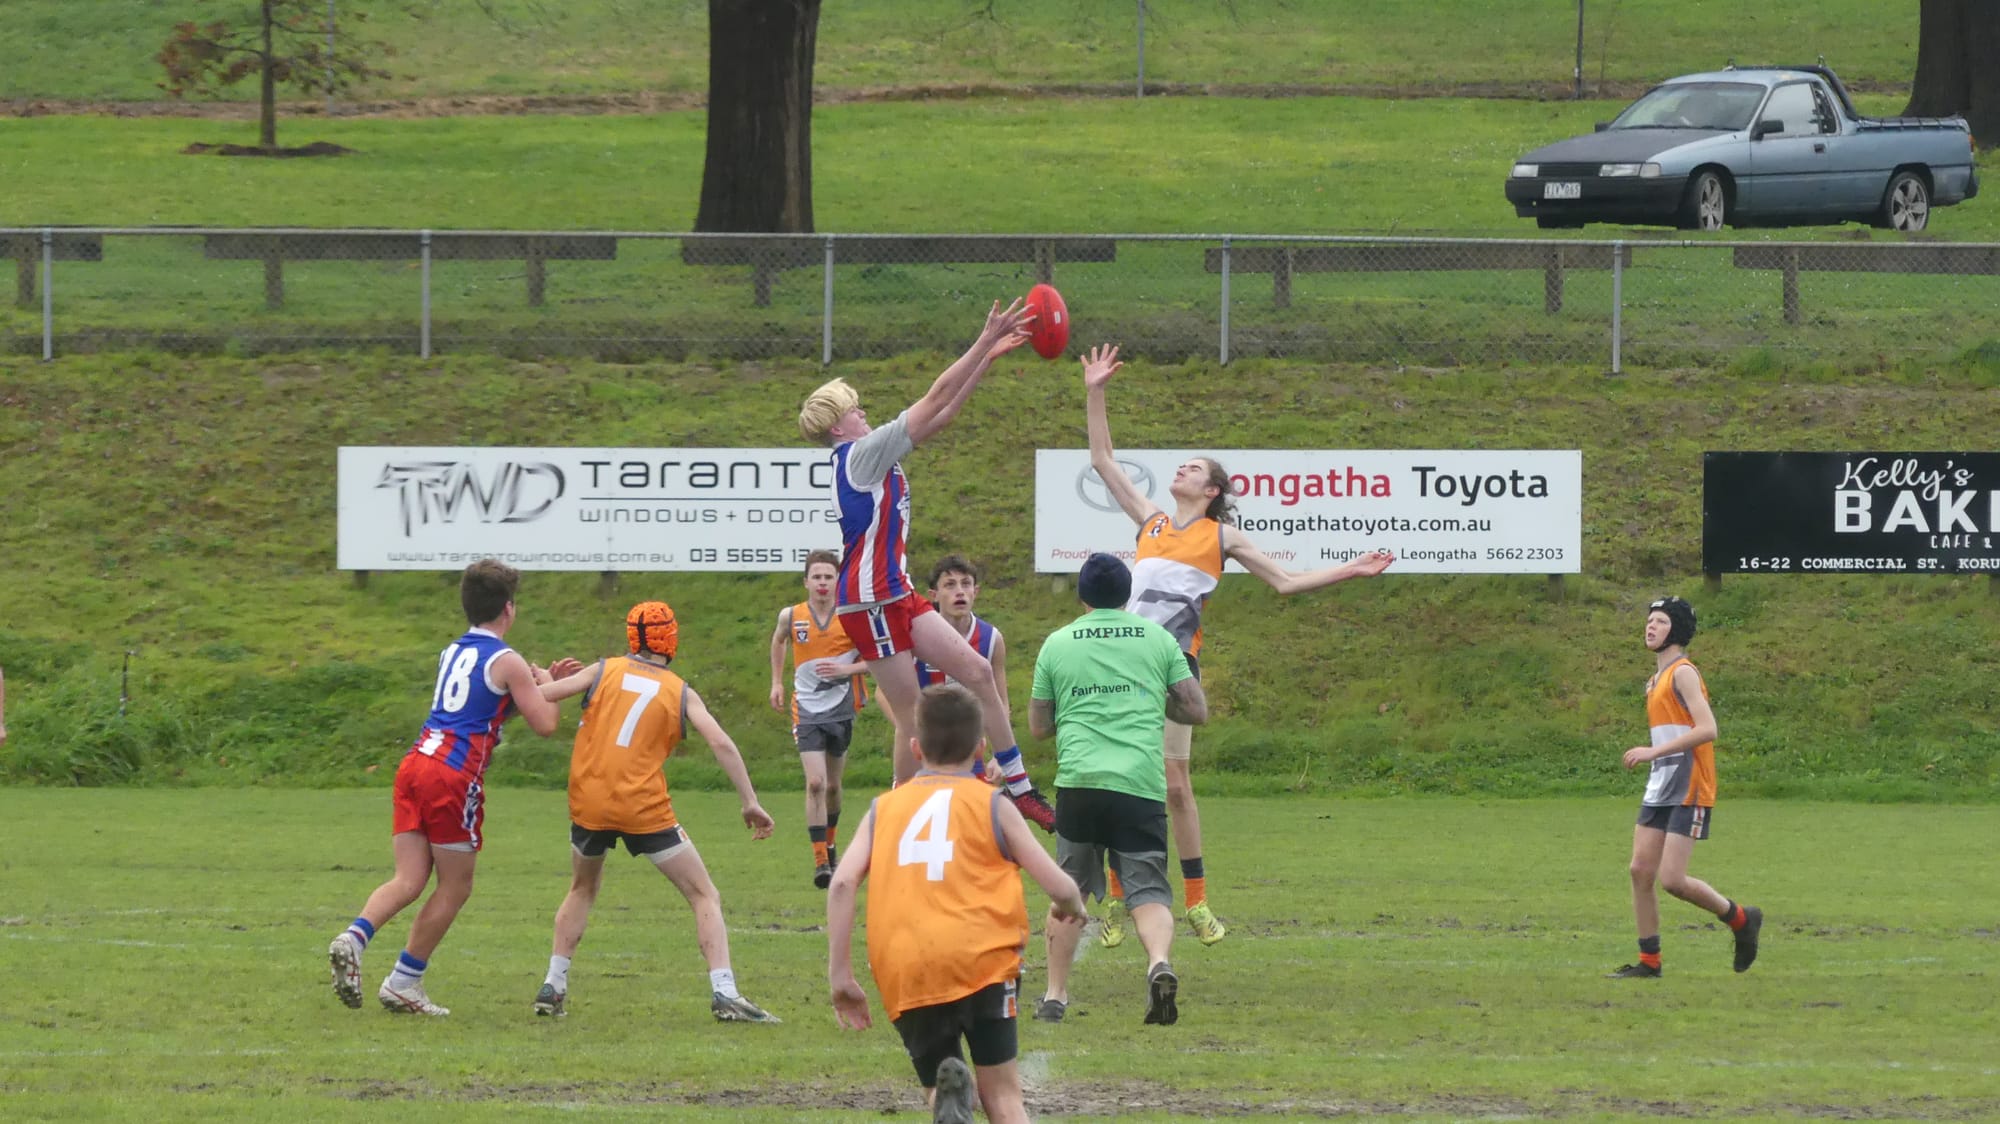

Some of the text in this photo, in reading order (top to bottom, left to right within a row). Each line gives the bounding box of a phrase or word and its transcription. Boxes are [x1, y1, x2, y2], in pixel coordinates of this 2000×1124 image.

[1229, 466, 1548, 506] ongatha Toyota
[1835, 457, 1974, 501] Kelly's
[726, 512, 737, 522] +
[1834, 490, 2000, 533] BAK
[1237, 515, 1491, 535] leongathatoyota.com.au
[1931, 534, 1993, 549] CAFE &
[690, 549, 717, 563] 03
[727, 549, 783, 563] 5655
[1051, 548, 1297, 562] Proud unity
[1401, 547, 1477, 563] Leongatha
[1486, 548, 1523, 560] 5662
[1527, 548, 1564, 560] 2303
[1739, 557, 1791, 570] 16-22
[1802, 557, 1906, 570] COMMERCIAL
[1917, 557, 1945, 570] ST.
[1072, 626, 1146, 640] UMPIRE
[1071, 683, 1131, 698] Fairhaven
[615, 673, 661, 748] 7
[897, 788, 954, 881] 4
